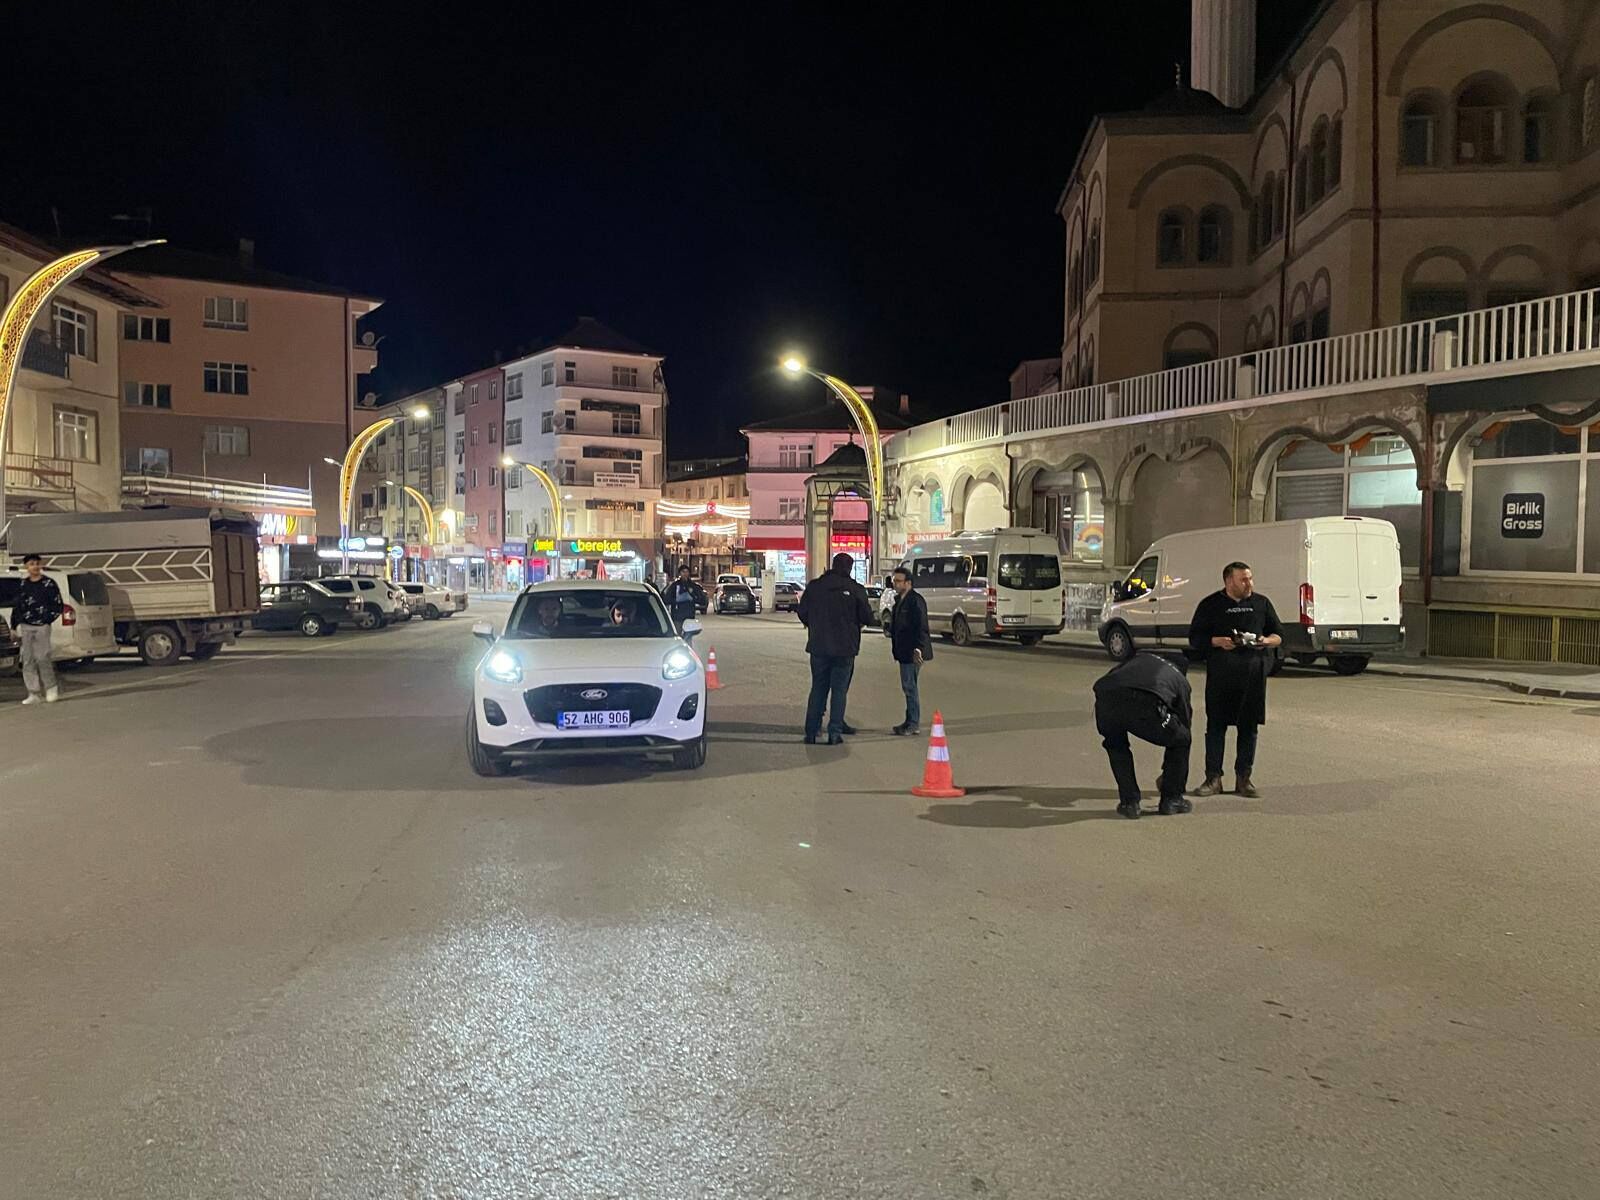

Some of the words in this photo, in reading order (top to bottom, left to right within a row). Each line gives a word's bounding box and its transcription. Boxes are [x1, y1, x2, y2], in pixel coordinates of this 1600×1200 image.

[1506, 502, 1540, 515] Birlik
[260, 513, 287, 535] AVM
[1503, 517, 1542, 530] Gross
[577, 539, 622, 552] bereket
[564, 713, 578, 725] 52
[583, 712, 604, 724] AHG
[608, 711, 629, 724] 906
